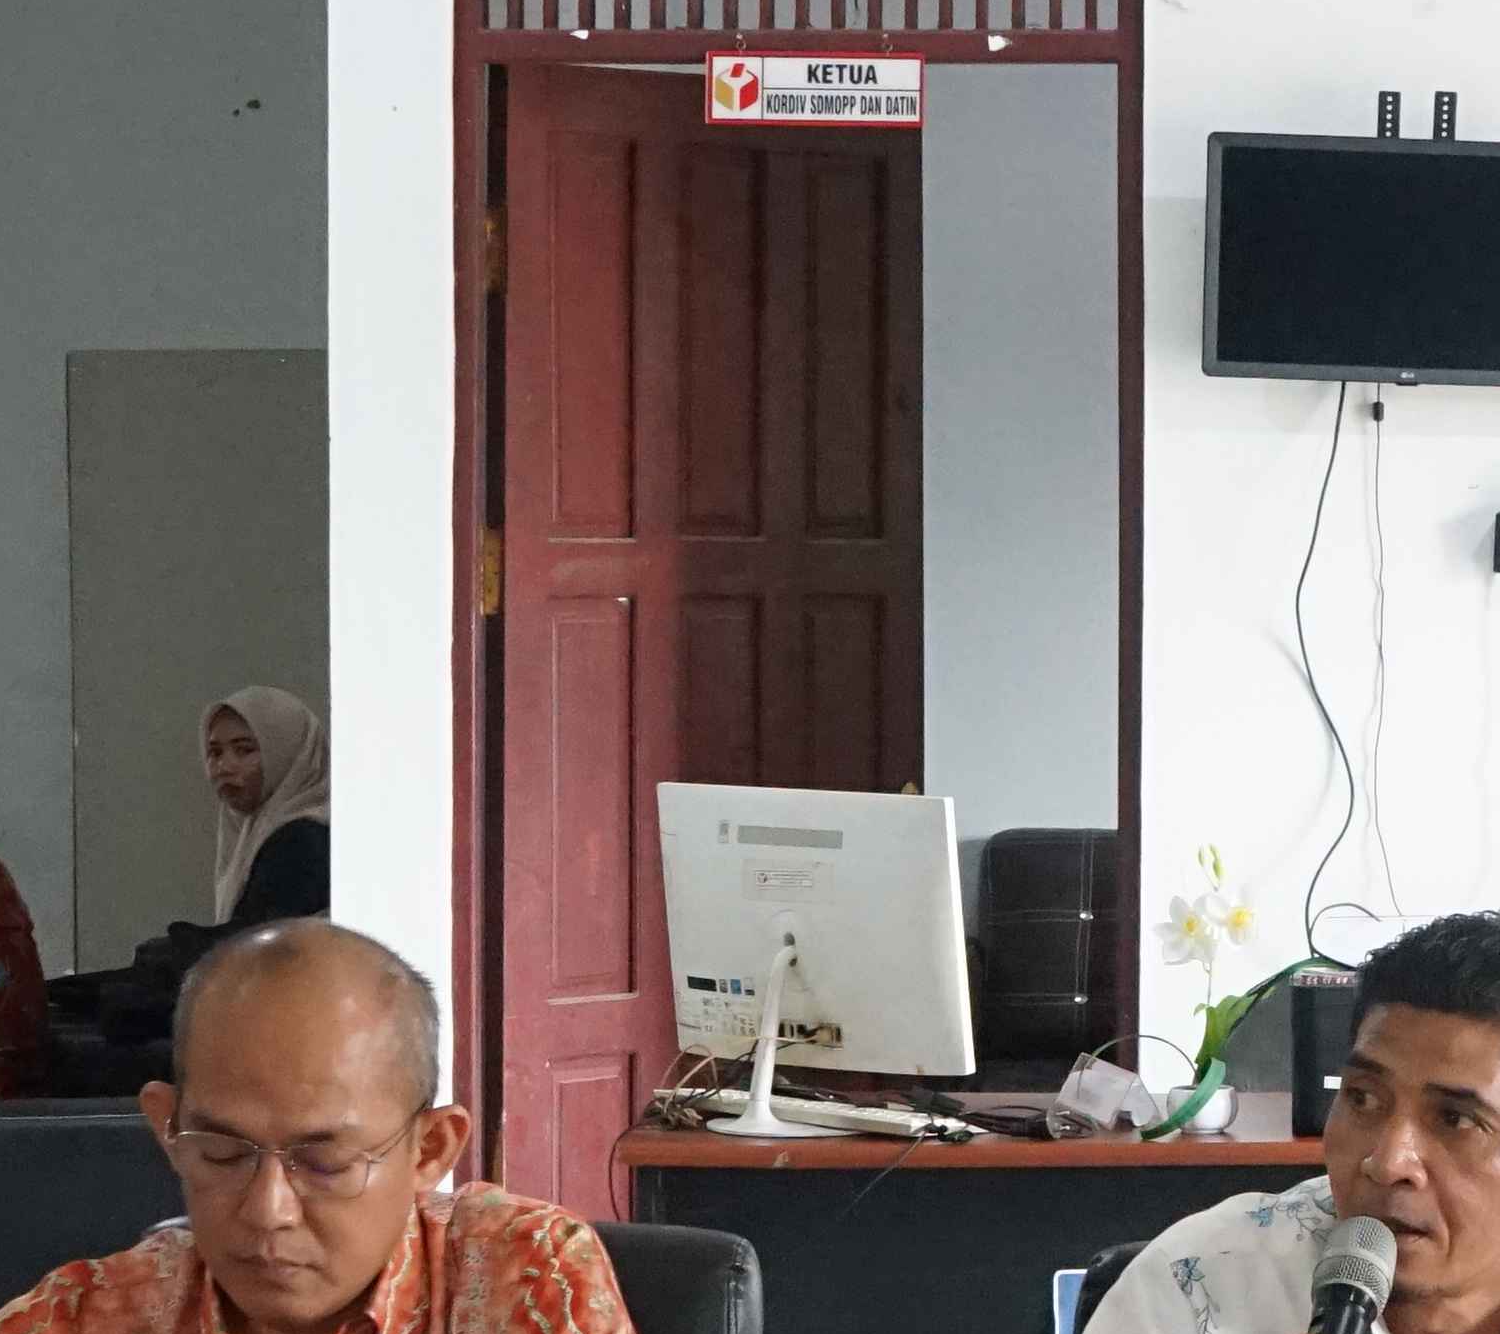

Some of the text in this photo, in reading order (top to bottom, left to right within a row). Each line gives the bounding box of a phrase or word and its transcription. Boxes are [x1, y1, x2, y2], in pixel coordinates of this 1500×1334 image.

[807, 64, 878, 85] KETUA
[766, 93, 917, 116] KORDIV SDMOPP DAN DATIN
